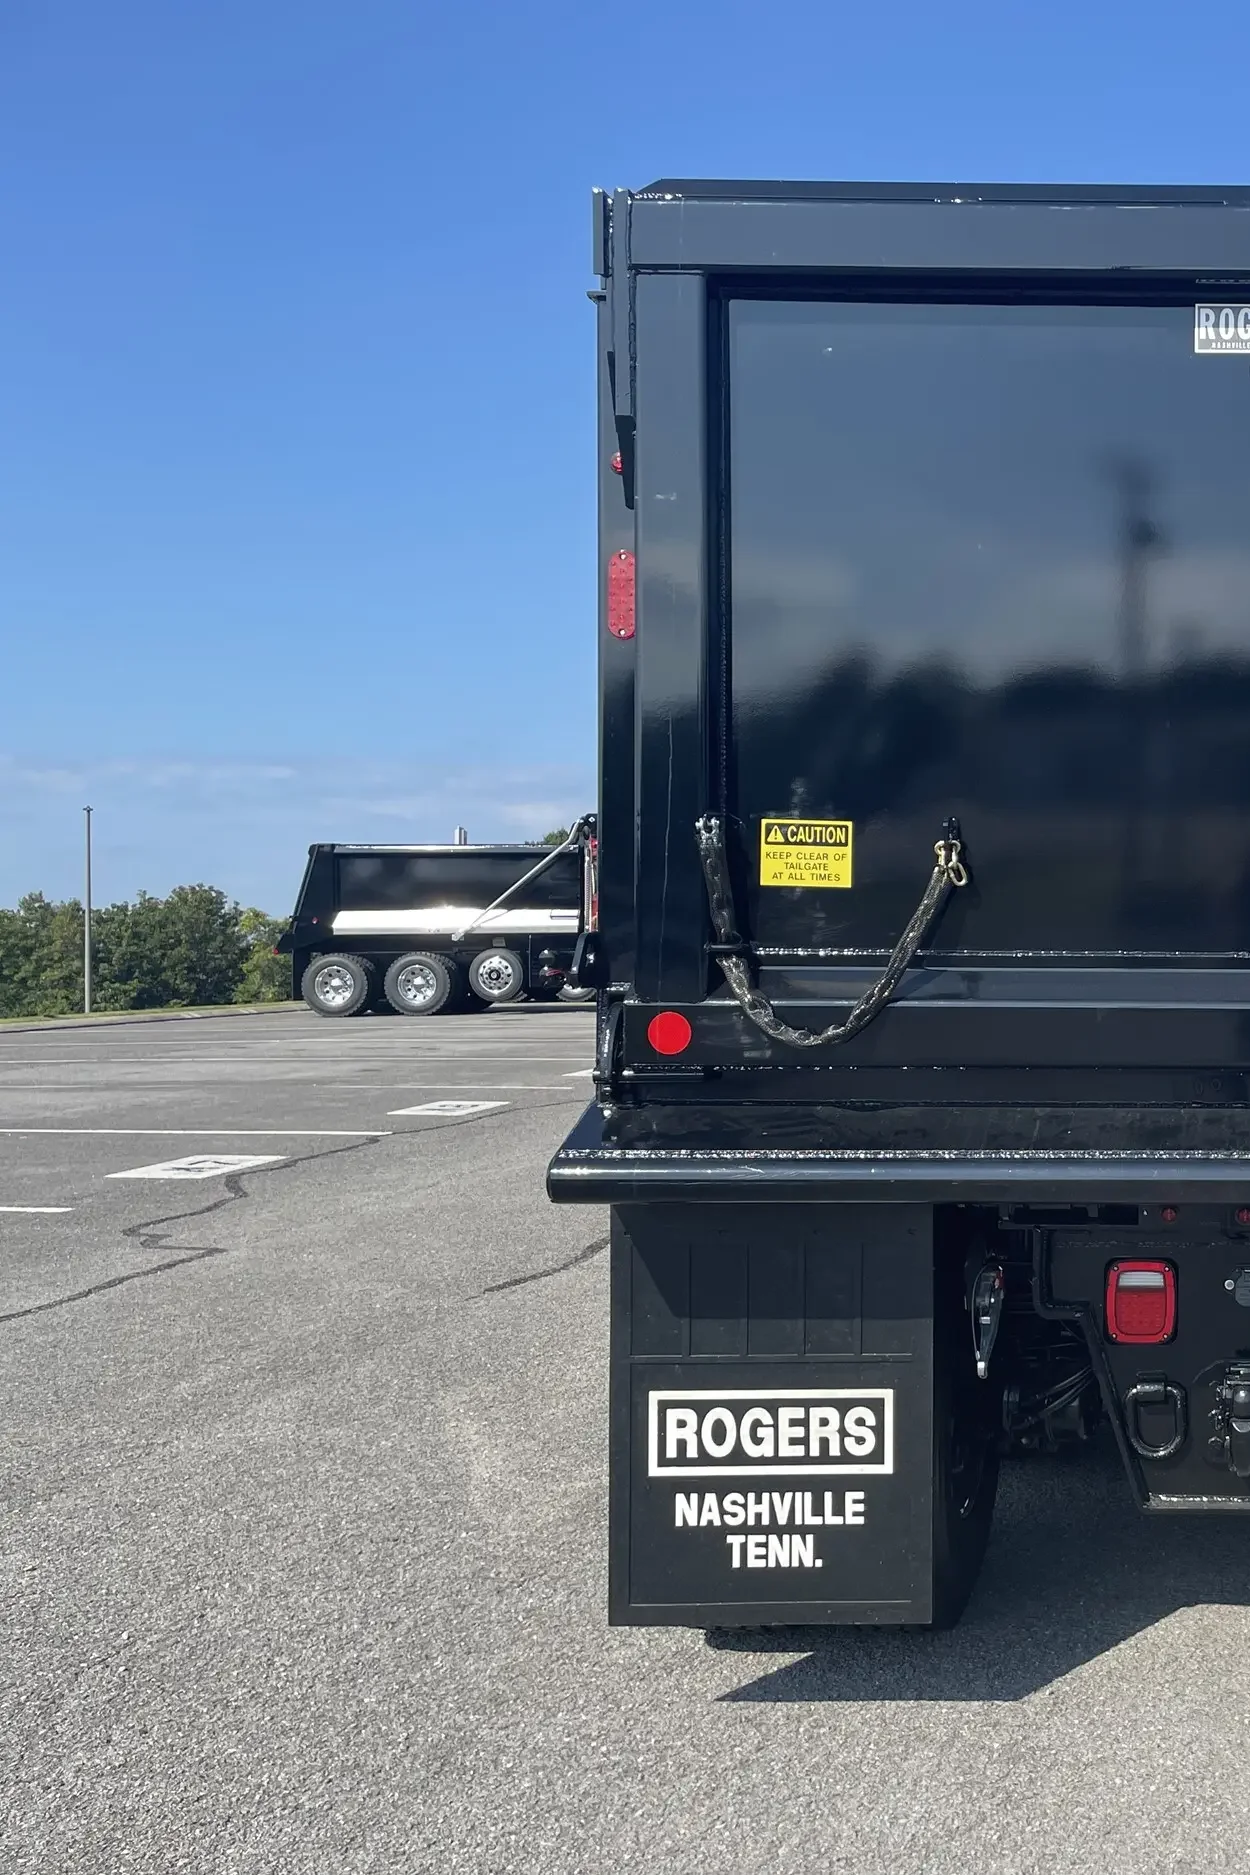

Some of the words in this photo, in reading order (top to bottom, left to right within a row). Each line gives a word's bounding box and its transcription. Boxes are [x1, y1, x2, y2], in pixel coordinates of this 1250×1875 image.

[787, 825, 846, 844] CAUTION
[765, 851, 792, 860] KEEP
[796, 852, 829, 861] CLEAR
[833, 853, 848, 861] OF
[784, 862, 829, 871] TAILGATE
[772, 872, 784, 880] AT
[788, 873, 806, 881] ALL
[810, 873, 841, 882] TIMES
[665, 1406, 877, 1459] ROGERS
[675, 1491, 865, 1527] NASHVILLE
[726, 1534, 823, 1569] TENN.
